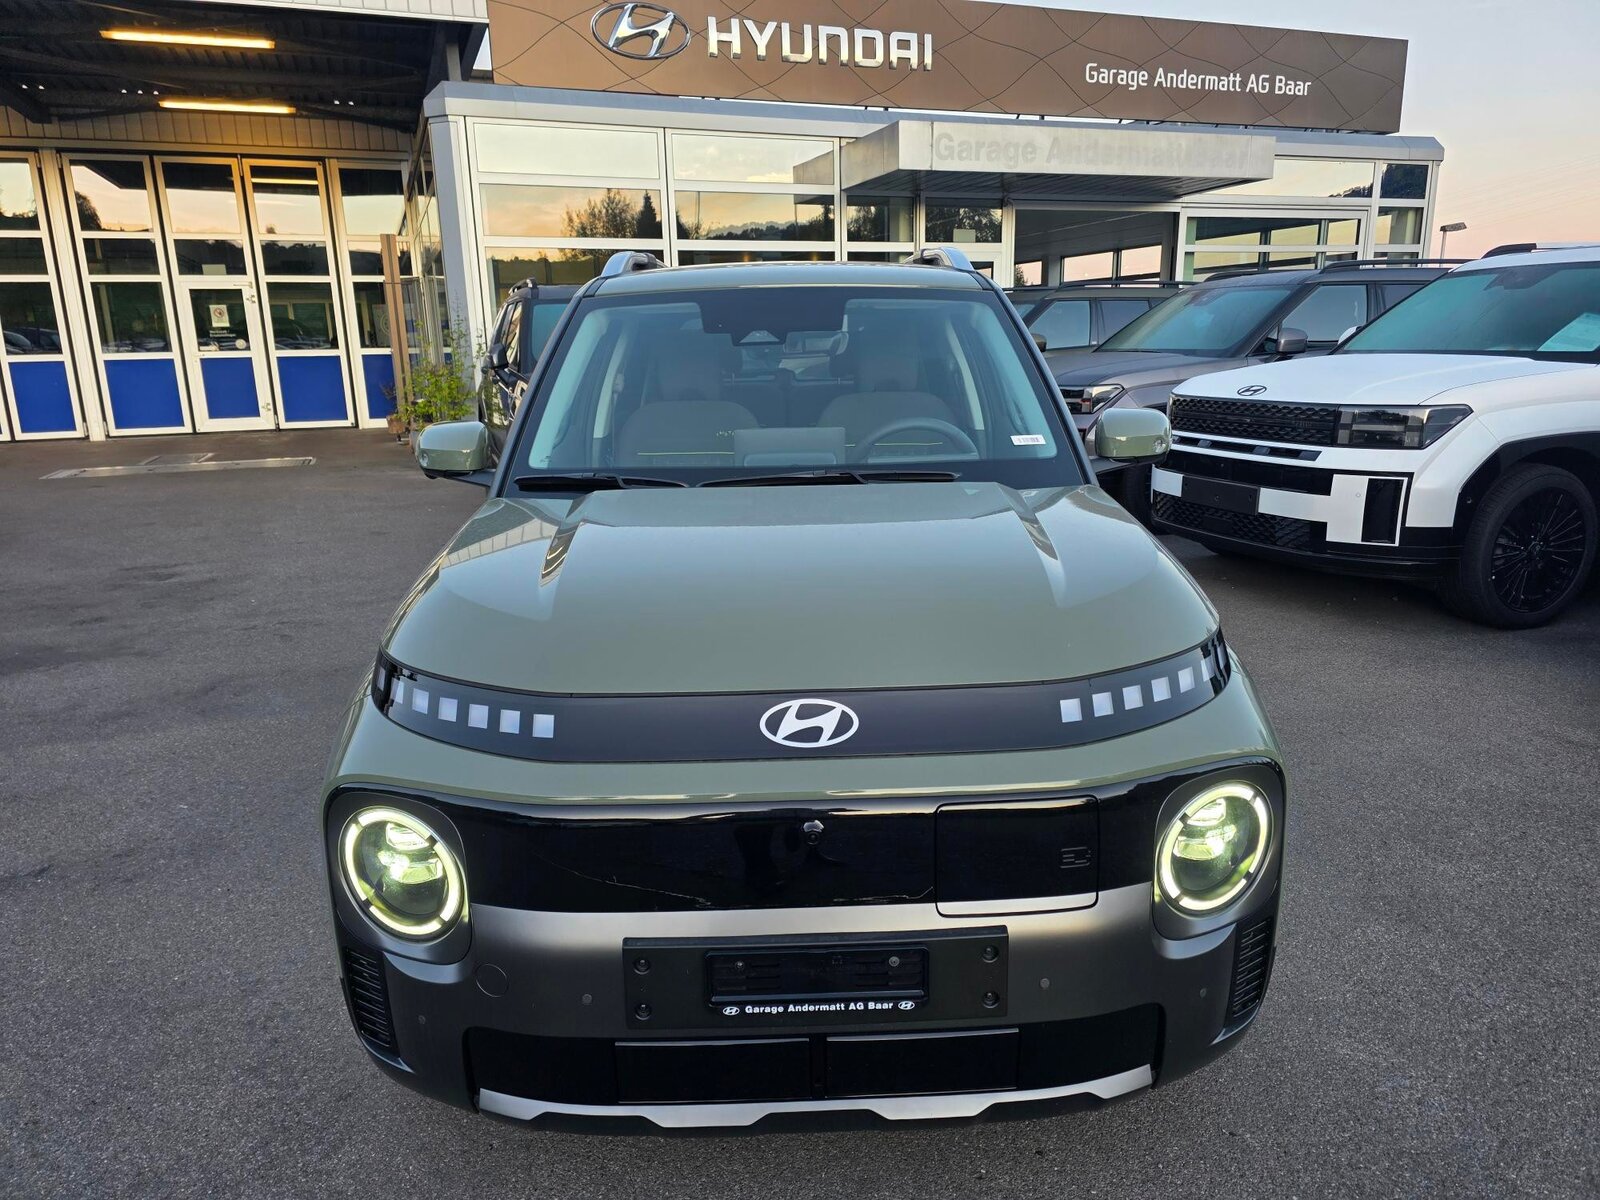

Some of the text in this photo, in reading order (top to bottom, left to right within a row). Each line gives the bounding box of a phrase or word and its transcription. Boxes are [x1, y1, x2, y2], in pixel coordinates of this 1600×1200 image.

[707, 16, 933, 71] HYUNDAI
[1085, 63, 1311, 96] Garage Andermatt AG Baar
[934, 132, 1037, 169] Garage
[745, 1001, 893, 1015] Garage Andermatt AG Baar
